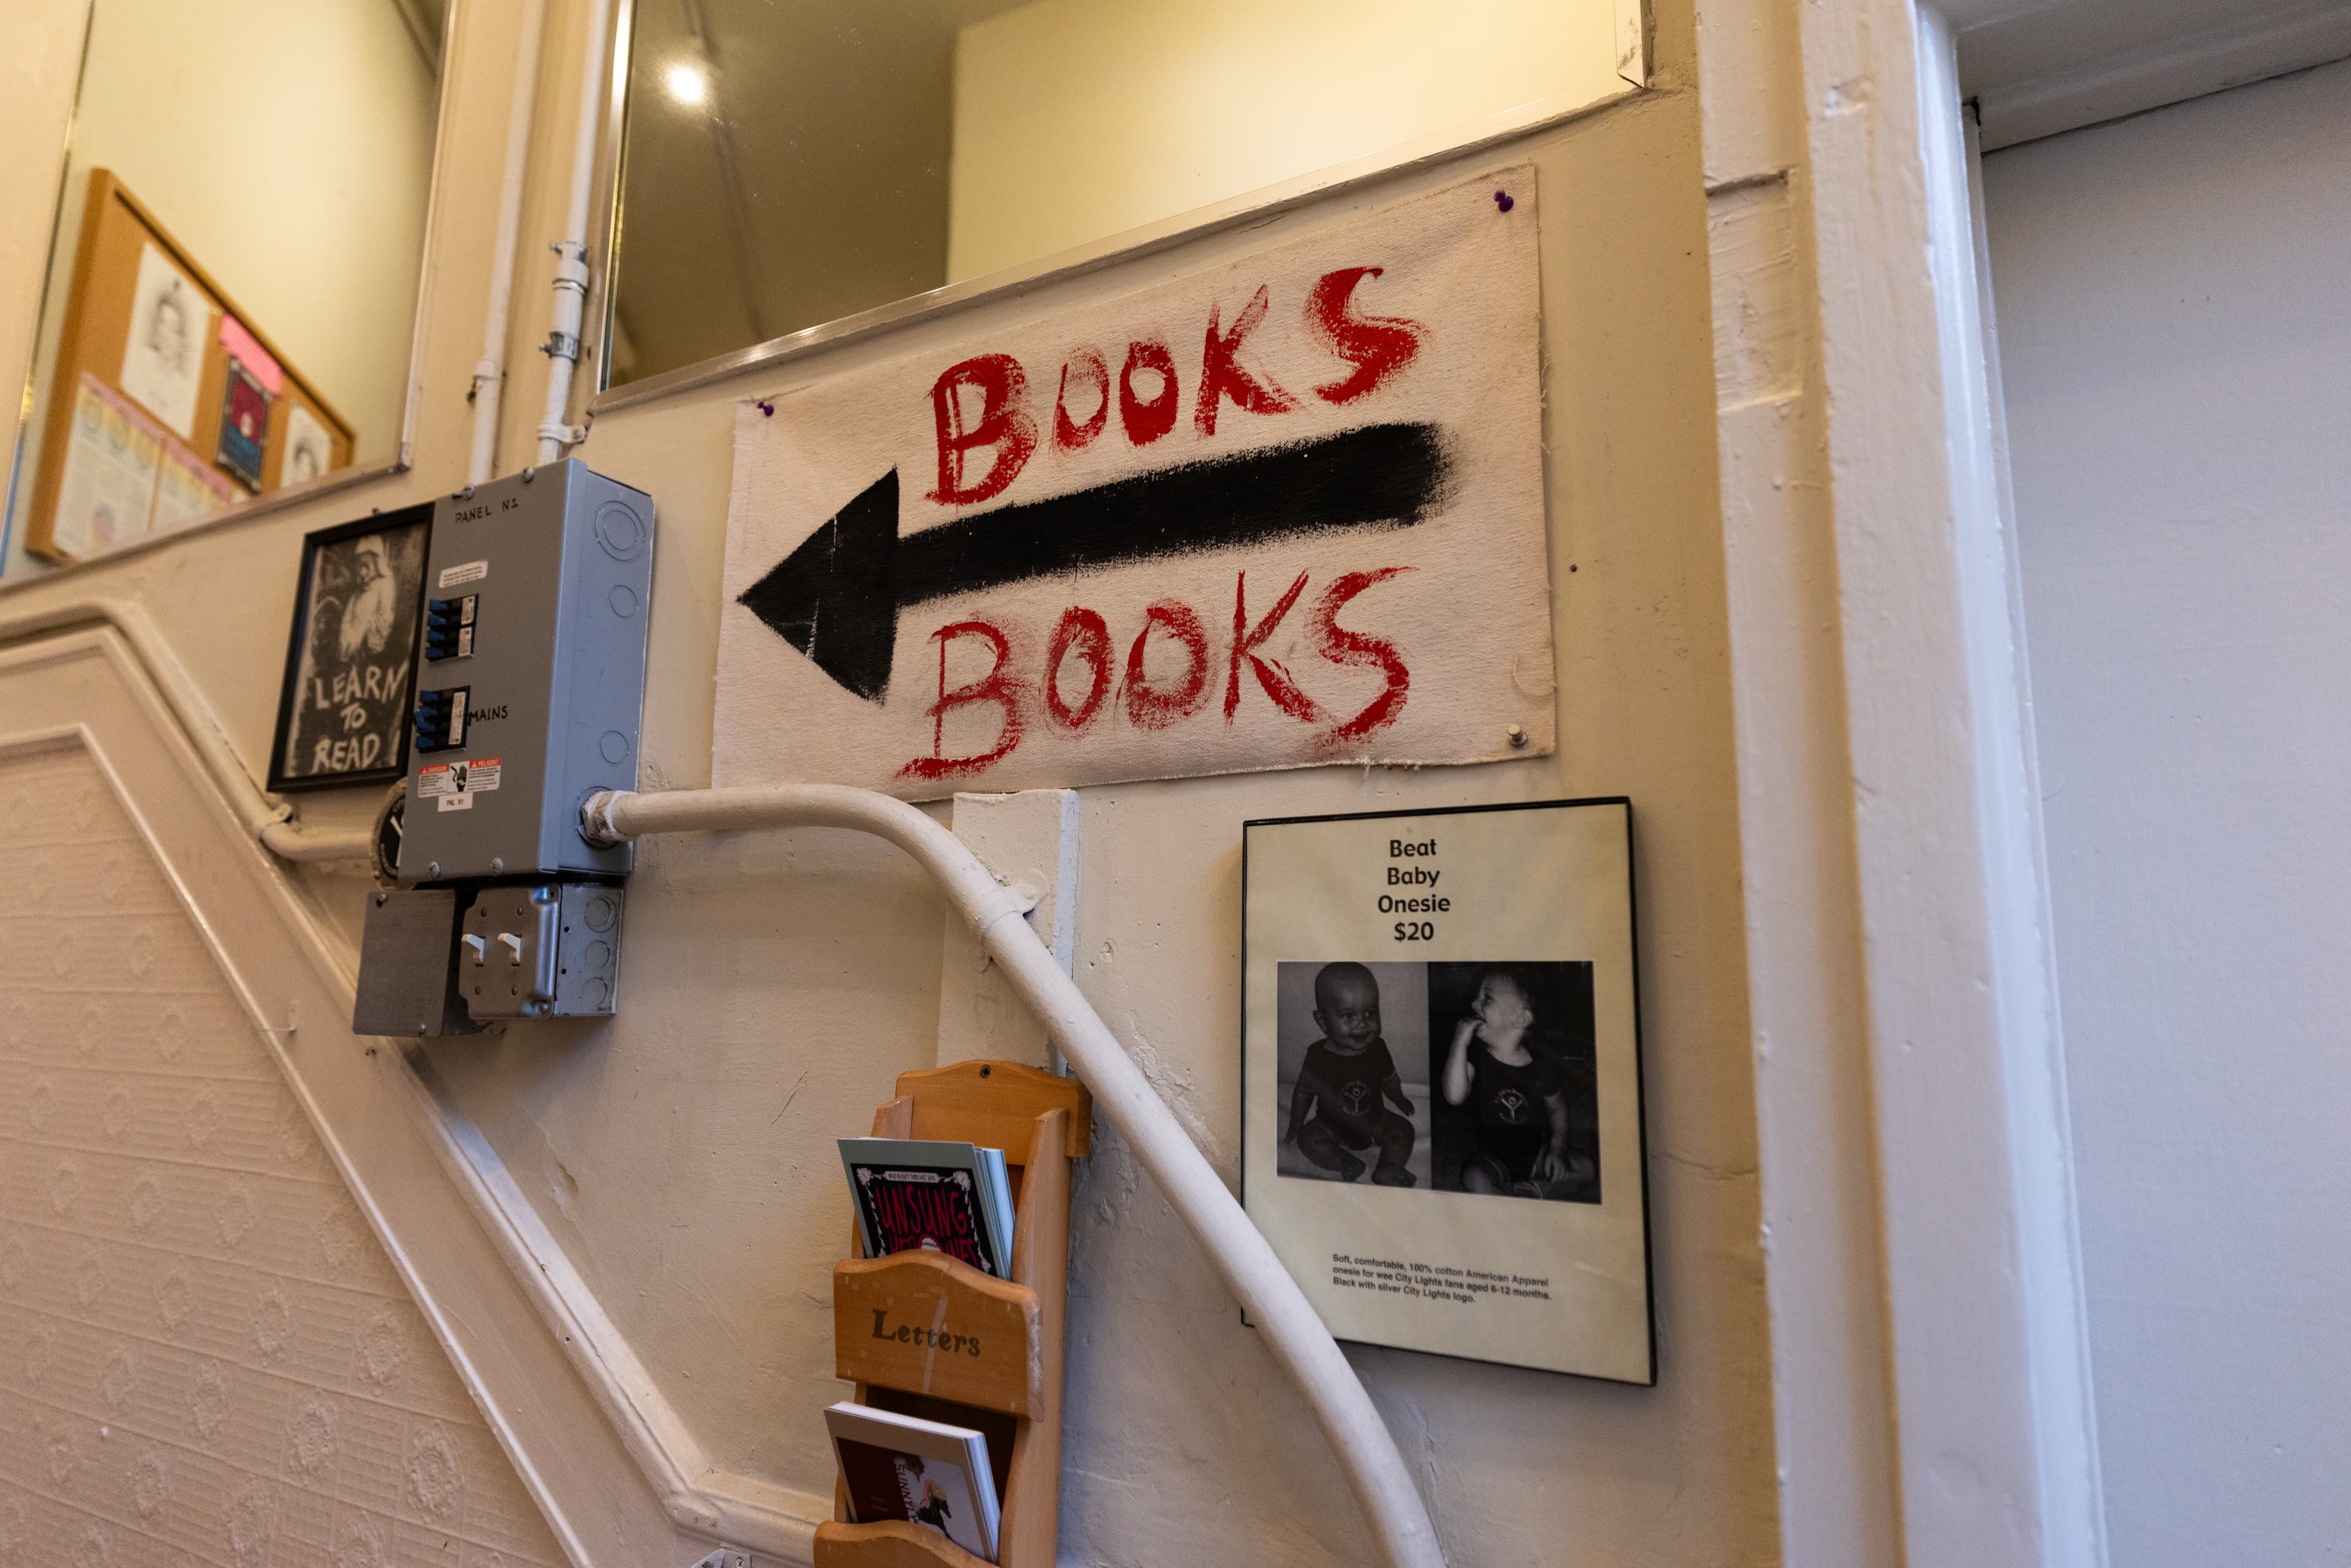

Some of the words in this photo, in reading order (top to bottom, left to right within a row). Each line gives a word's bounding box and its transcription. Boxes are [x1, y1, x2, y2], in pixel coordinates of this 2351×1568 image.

[924, 266, 1428, 506] BOOKS
[455, 505, 492, 524] PANEL
[502, 497, 519, 512] N1
[314, 658, 409, 710] LEARN
[896, 565, 1419, 781] BOOKS
[339, 702, 367, 733] TO
[467, 705, 508, 727] MAINS
[309, 733, 381, 775] READ
[1390, 839, 1437, 857] Beat
[1387, 866, 1441, 888] Baby
[1378, 894, 1451, 913] Onesie
[1393, 921, 1434, 943] $20
[875, 1184, 967, 1237] UNSUNG
[1332, 1255, 1352, 1264] Soft,
[1354, 1257, 1407, 1272] comfortable,
[1409, 1263, 1433, 1274] 100%
[1434, 1267, 1463, 1277] cotton
[1466, 1269, 1509, 1283] American
[1512, 1274, 1549, 1288] Apparel
[1332, 1267, 1361, 1277] onesie
[1362, 1269, 1374, 1278] for
[1376, 1272, 1393, 1281] wee
[1395, 1273, 1413, 1285] City
[1414, 1275, 1443, 1288] Lights
[1445, 1279, 1464, 1289] fans
[1467, 1283, 1489, 1293] aged
[1491, 1285, 1511, 1296] 6-12
[1513, 1289, 1553, 1300] months.
[1333, 1277, 1357, 1288] Black
[1358, 1280, 1376, 1291] with
[1378, 1283, 1401, 1294] silver
[1403, 1285, 1421, 1298] City
[1422, 1288, 1451, 1300] Lights
[1453, 1292, 1475, 1304] logo.
[872, 1308, 981, 1357] Letters
